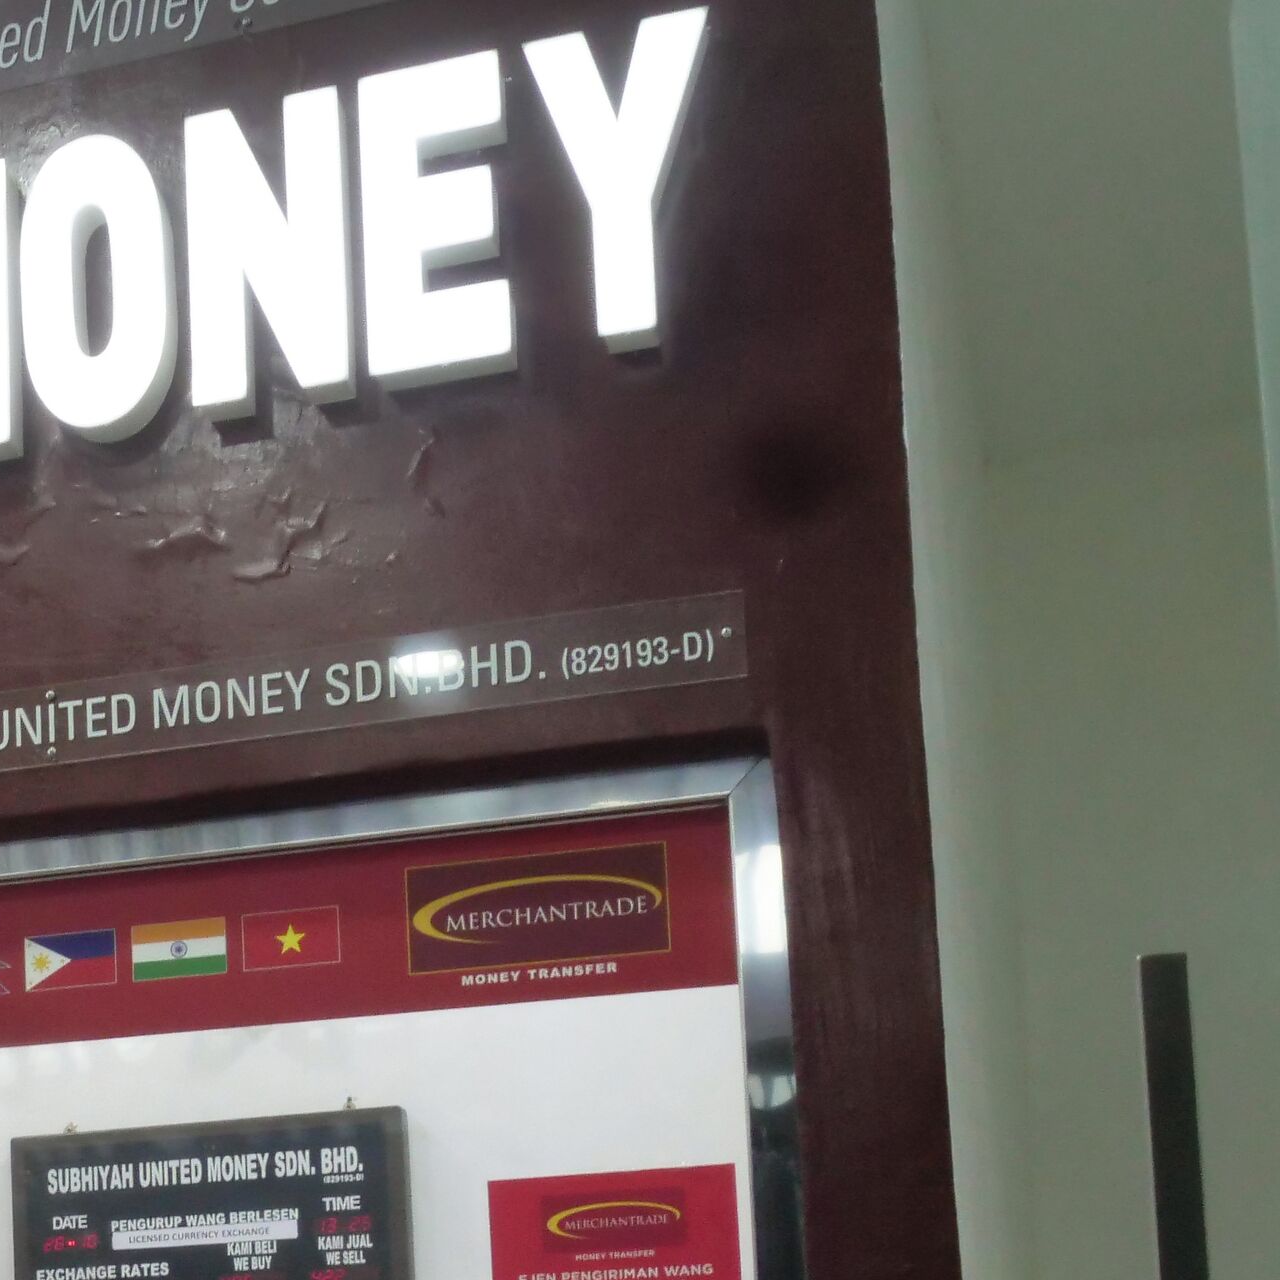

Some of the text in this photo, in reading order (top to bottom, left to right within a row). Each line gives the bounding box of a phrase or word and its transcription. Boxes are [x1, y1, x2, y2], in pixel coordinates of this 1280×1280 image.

[151, 668, 311, 732] MONEY
[562, 629, 714, 680] (829193-D)
[447, 896, 648, 933] MERCHANTRADE
[461, 963, 617, 986] MONEY TRANSFER
[48, 1146, 363, 1194] SUBHIYAH UNITED MONEY SDN. BHD.
[322, 1196, 360, 1211] TIME
[53, 1215, 88, 1230] DATE
[111, 1208, 298, 1232] PENGURUP WANG BERLESEN
[565, 1213, 668, 1232] MERCHANTRADE
[129, 1227, 270, 1244] LICENSED CURRENCY EXCHANGE
[318, 1234, 373, 1250] KAMI JUAL
[227, 1240, 277, 1256] KAMI BELI
[575, 1249, 655, 1261] MONEY TRANSFER
[234, 1256, 272, 1271] WE BUY
[326, 1251, 366, 1265] WE SELL
[121, 1262, 169, 1278] RATES
[664, 1263, 714, 1276] WANG
